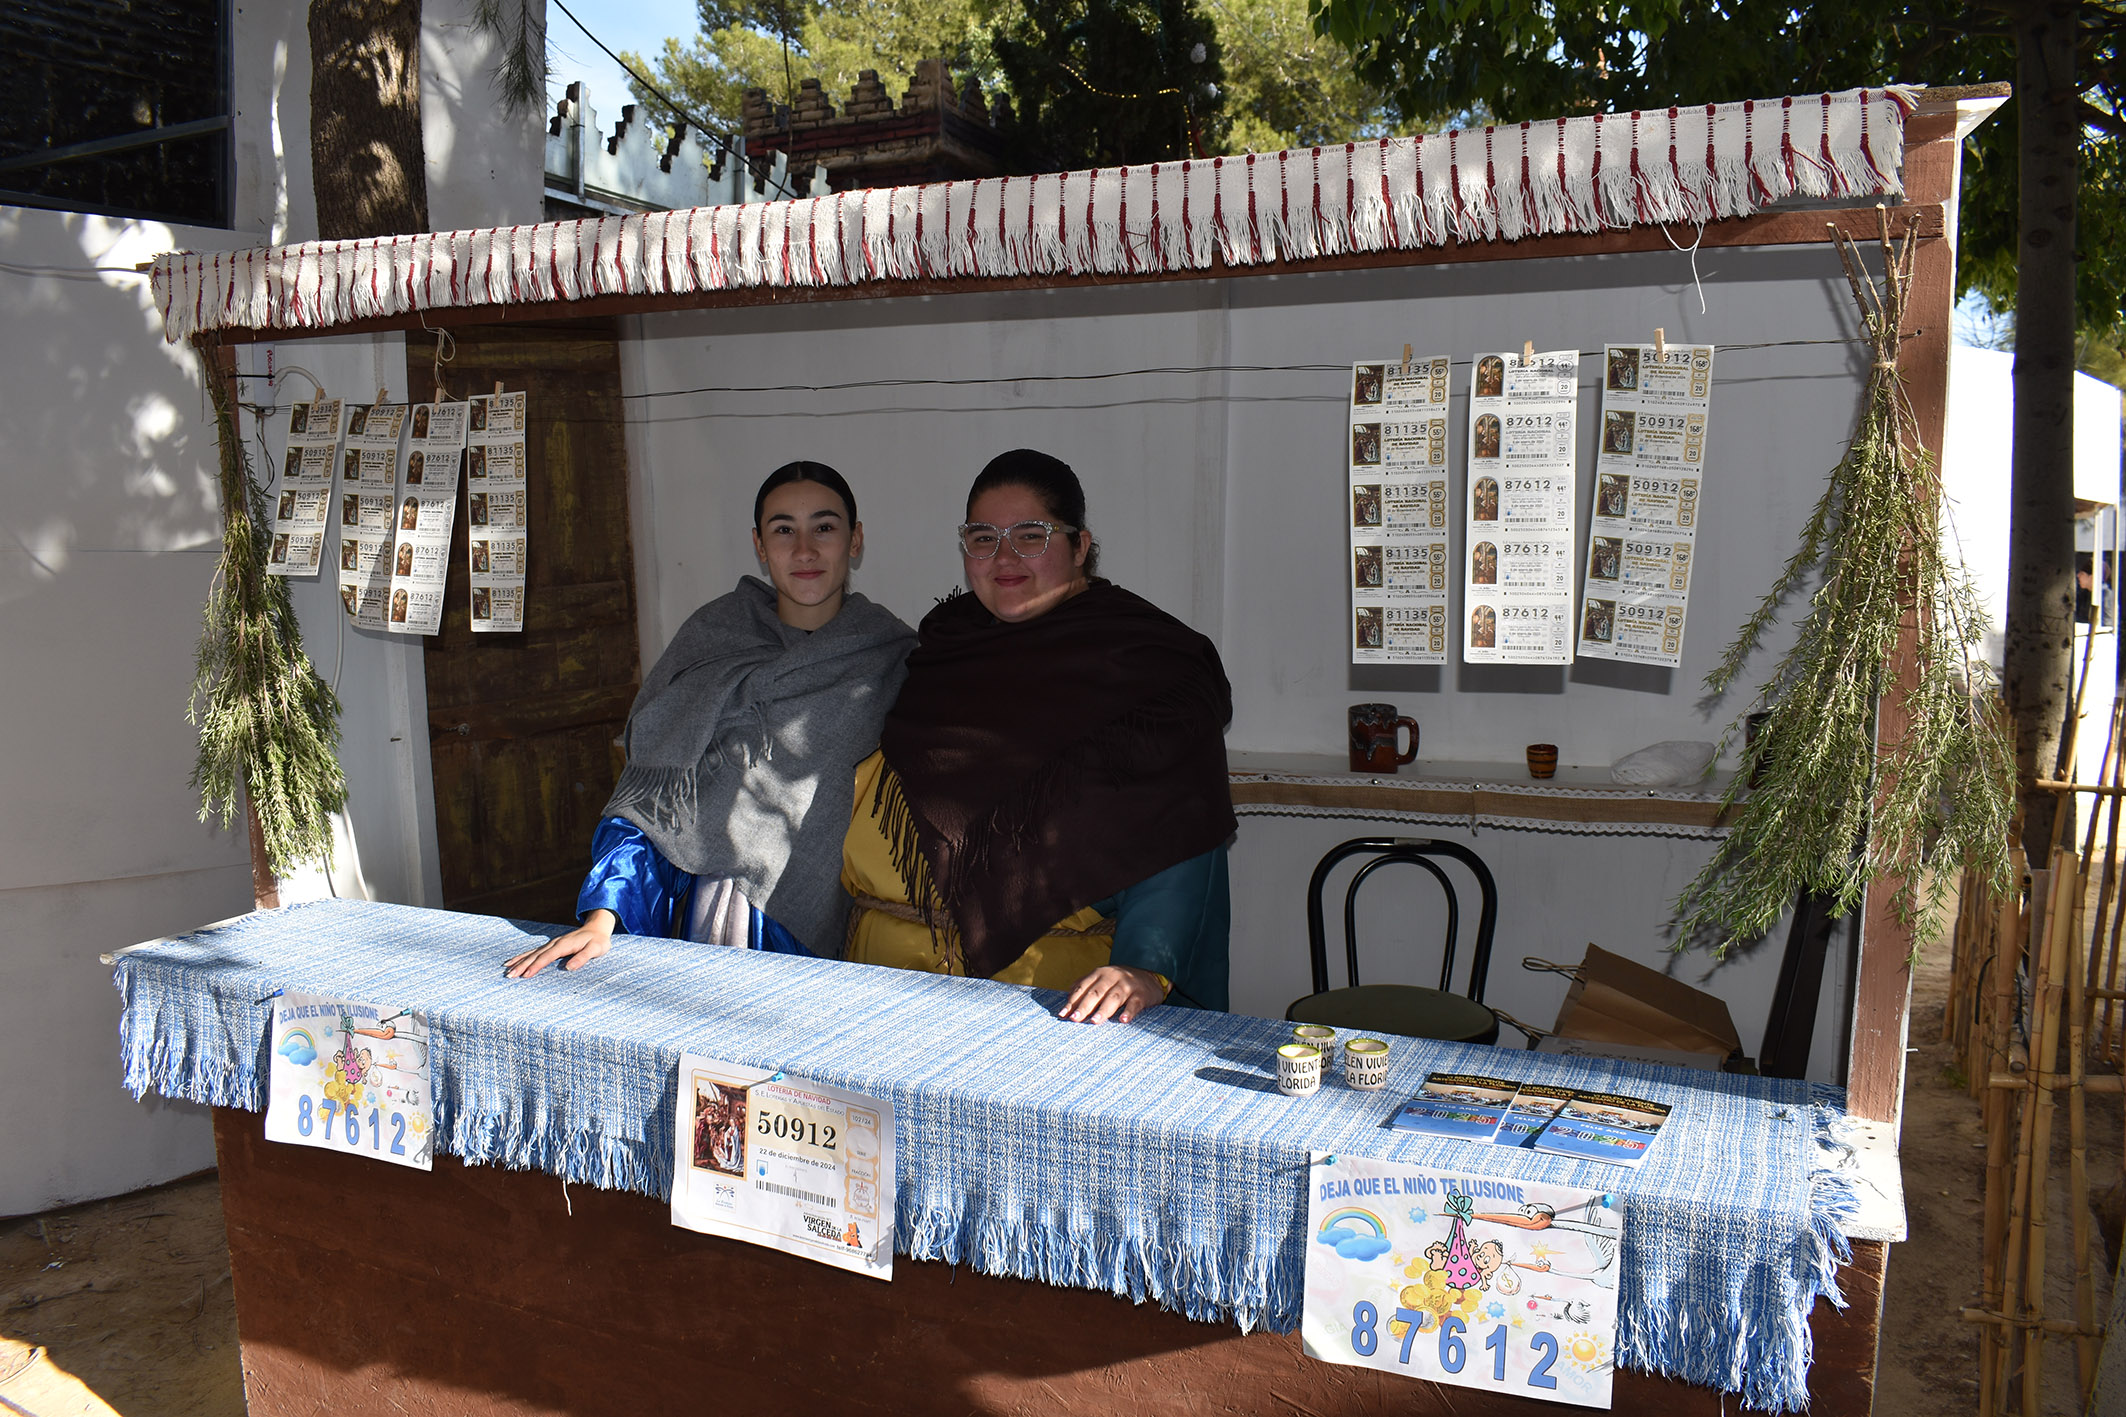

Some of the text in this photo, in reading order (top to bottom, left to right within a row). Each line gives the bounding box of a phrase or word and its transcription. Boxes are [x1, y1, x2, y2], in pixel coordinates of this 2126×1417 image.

[489, 399, 514, 408] 8135
[371, 408, 395, 416] 50912
[1506, 416, 1552, 426] 87612
[1639, 417, 1684, 428] 50912
[1385, 424, 1427, 434] 81135
[304, 449, 326, 457] 50912
[361, 452, 385, 460] 50912
[487, 447, 513, 456] 81135
[426, 454, 450, 462] 87612
[1505, 480, 1550, 489] 87612
[1633, 480, 1678, 492] 50912
[297, 492, 320, 500] 50912
[1385, 487, 1428, 496] 81135
[360, 497, 383, 506] 50912
[489, 494, 515, 503] 81135
[421, 500, 444, 508] 87612
[291, 536, 313, 544] 50912
[359, 543, 383, 552] 50912
[415, 546, 439, 554] 87612
[491, 542, 515, 551] 81135
[1504, 544, 1550, 553] 87612
[1626, 543, 1671, 556] 50912
[1386, 549, 1428, 558] 81135
[358, 588, 382, 598] 50912
[410, 592, 433, 600] 87612
[492, 589, 514, 598] 81135
[1386, 610, 1428, 619] 81135
[1502, 608, 1548, 617] 87612
[1618, 606, 1664, 619] 50912
[279, 1001, 380, 1024] DEJA QUE EL NIÑO TE ILUSIONE
[1278, 1075, 1316, 1090] FLORIDA
[793, 1090, 803, 1099] DE
[803, 1092, 831, 1105] NAVIDAD
[1624, 1098, 1655, 1107] VIVIENTE
[1637, 1103, 1667, 1113] FLORIDA
[852, 1115, 871, 1125] 102/24
[1408, 1106, 1491, 1125] 2025
[297, 1094, 406, 1156] 87612
[757, 1110, 837, 1150] 50912
[1552, 1126, 1639, 1149] 2025
[759, 1147, 767, 1155] 22
[778, 1151, 810, 1165] diciembre
[810, 1159, 819, 1167] de
[820, 1161, 836, 1171] 2024
[1319, 1173, 1525, 1205] DEJA QUE EL NIÑO TE ILUSIONE
[803, 1214, 832, 1229] VIRGEN
[807, 1224, 842, 1240] SALCEDA
[1351, 1300, 1559, 1390] 87612
